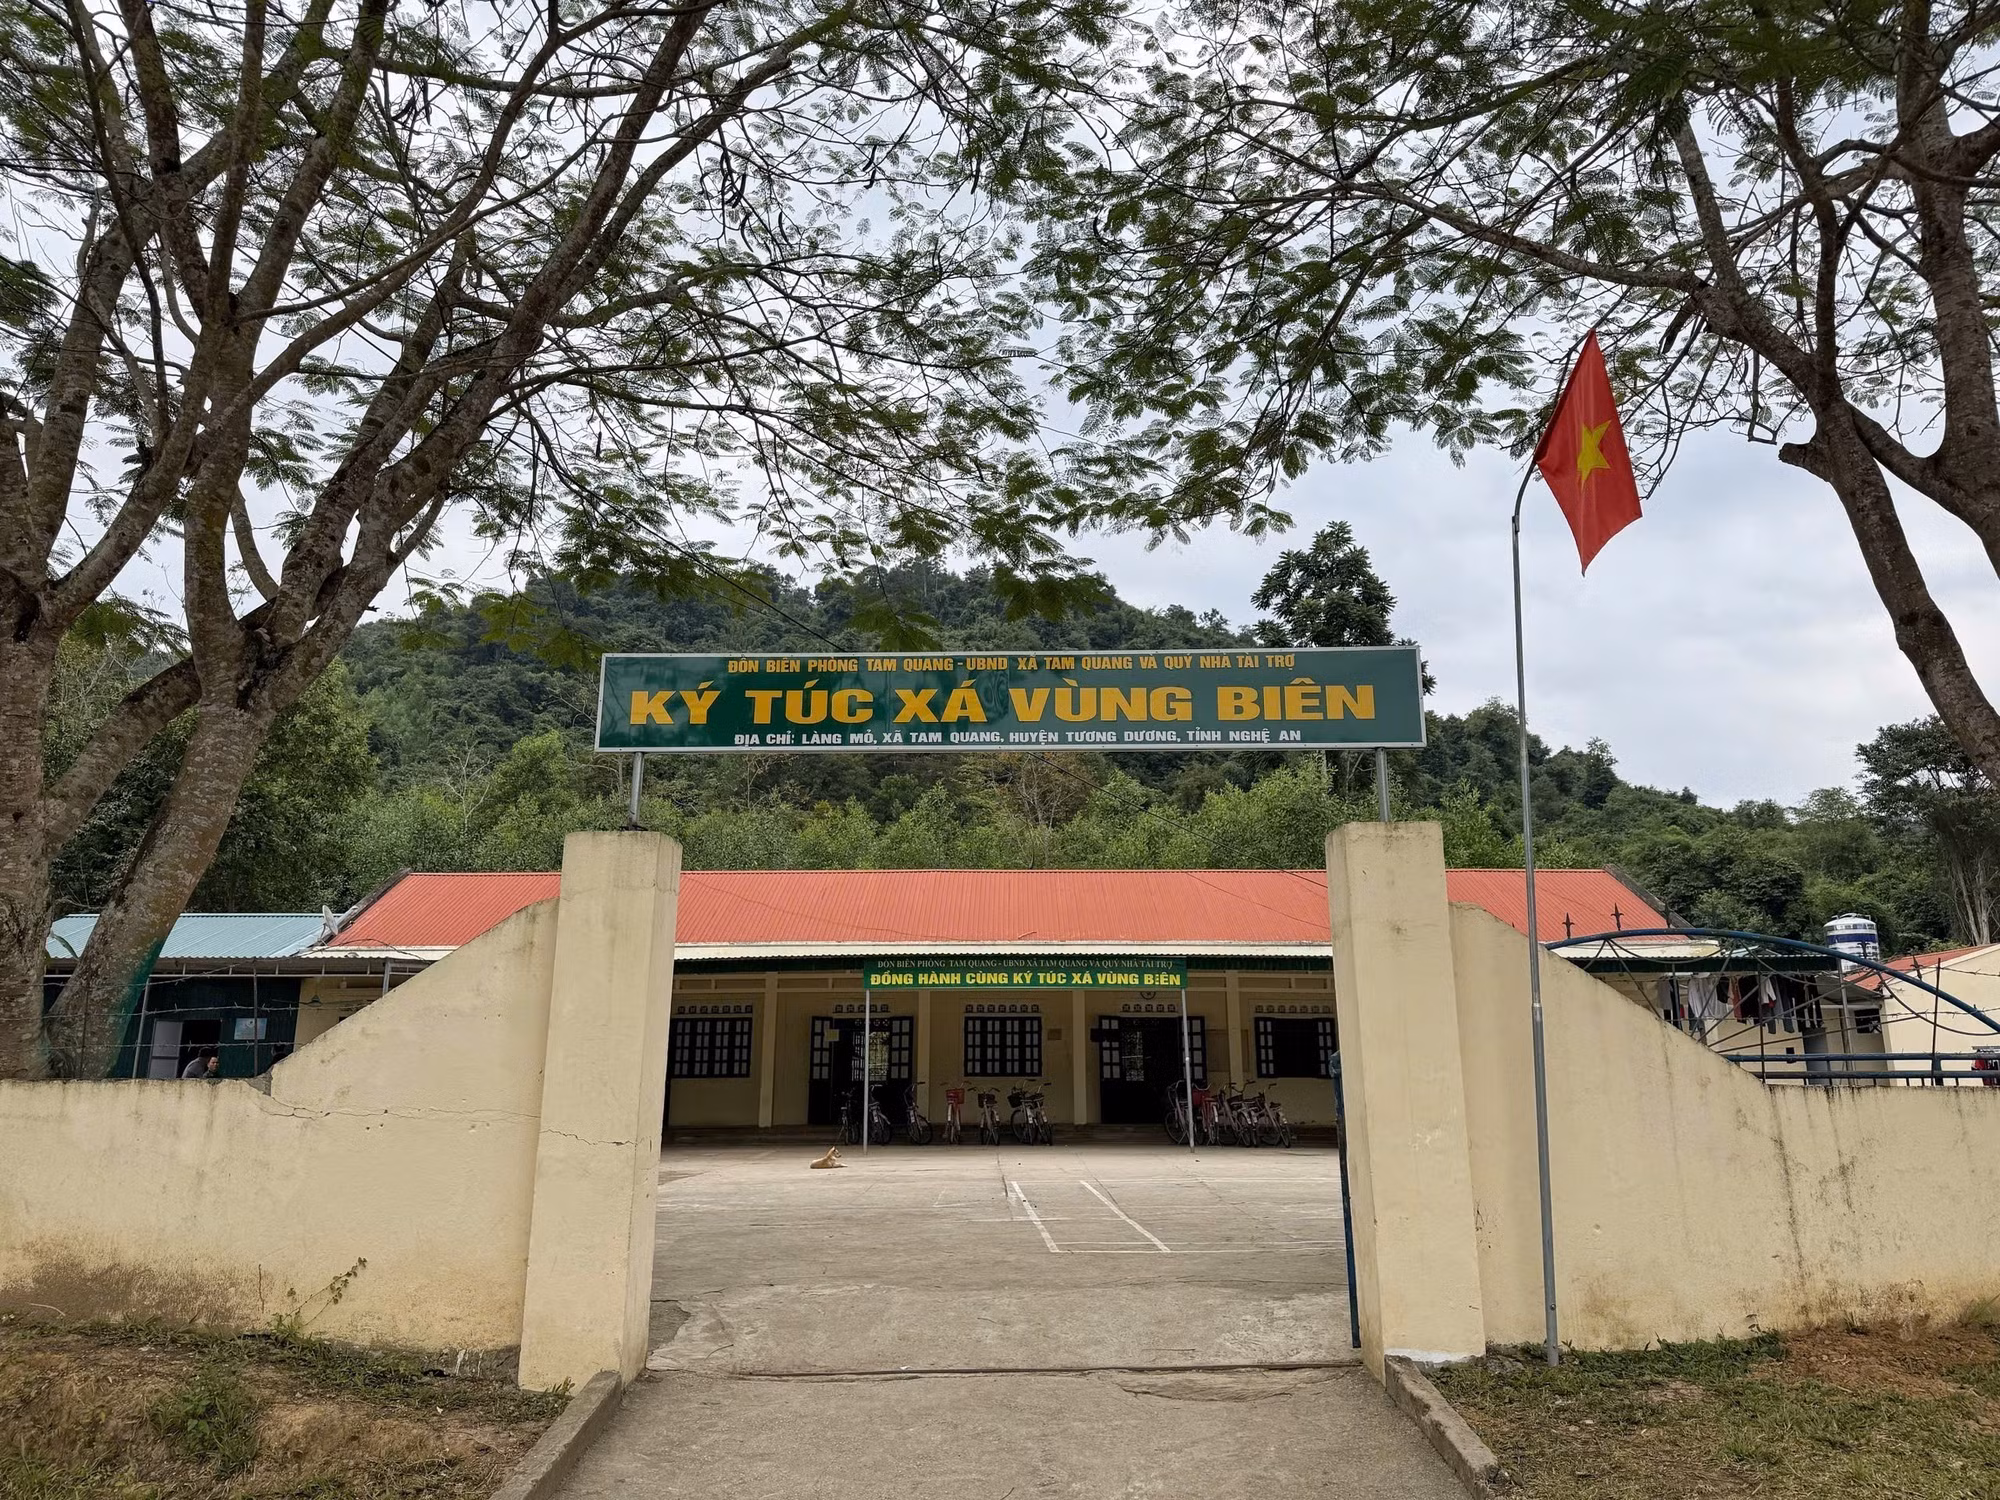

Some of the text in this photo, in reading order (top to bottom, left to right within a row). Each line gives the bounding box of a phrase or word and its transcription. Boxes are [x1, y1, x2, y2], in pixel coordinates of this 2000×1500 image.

[807, 656, 859, 673] PHÒNG
[866, 658, 897, 672] TAM
[903, 657, 954, 672] QUANG
[965, 657, 1008, 671] UBND
[1044, 656, 1075, 671] TAM
[1081, 656, 1133, 671] QUANG
[1199, 652, 1232, 669] NHÀ
[1265, 653, 1296, 671] TRỢ
[629, 677, 1376, 725] KÝ TÚC XÁ VÙNG BIÊN
[733, 727, 1302, 747] ĐỊA CHỈ: LÀNG MỎ, XÃ TAM QUANG, HUYỆN TƯƠNG DƯƠNG, TỈNH NGHỆ AN
[917, 958, 946, 968] PHÒNG
[949, 959, 966, 967] TAM
[968, 959, 997, 968] QUANG
[1003, 959, 1025, 967] UBND
[1039, 959, 1057, 967] TAM
[1058, 959, 1088, 968] QUANG
[918, 970, 961, 985] HÀNH
[966, 970, 1009, 984] CÙNG
[1013, 970, 1033, 984] KÝ
[1037, 970, 1067, 984] TÚC
[1071, 970, 1093, 984] XÁ
[1097, 970, 1140, 985] VÙNG
